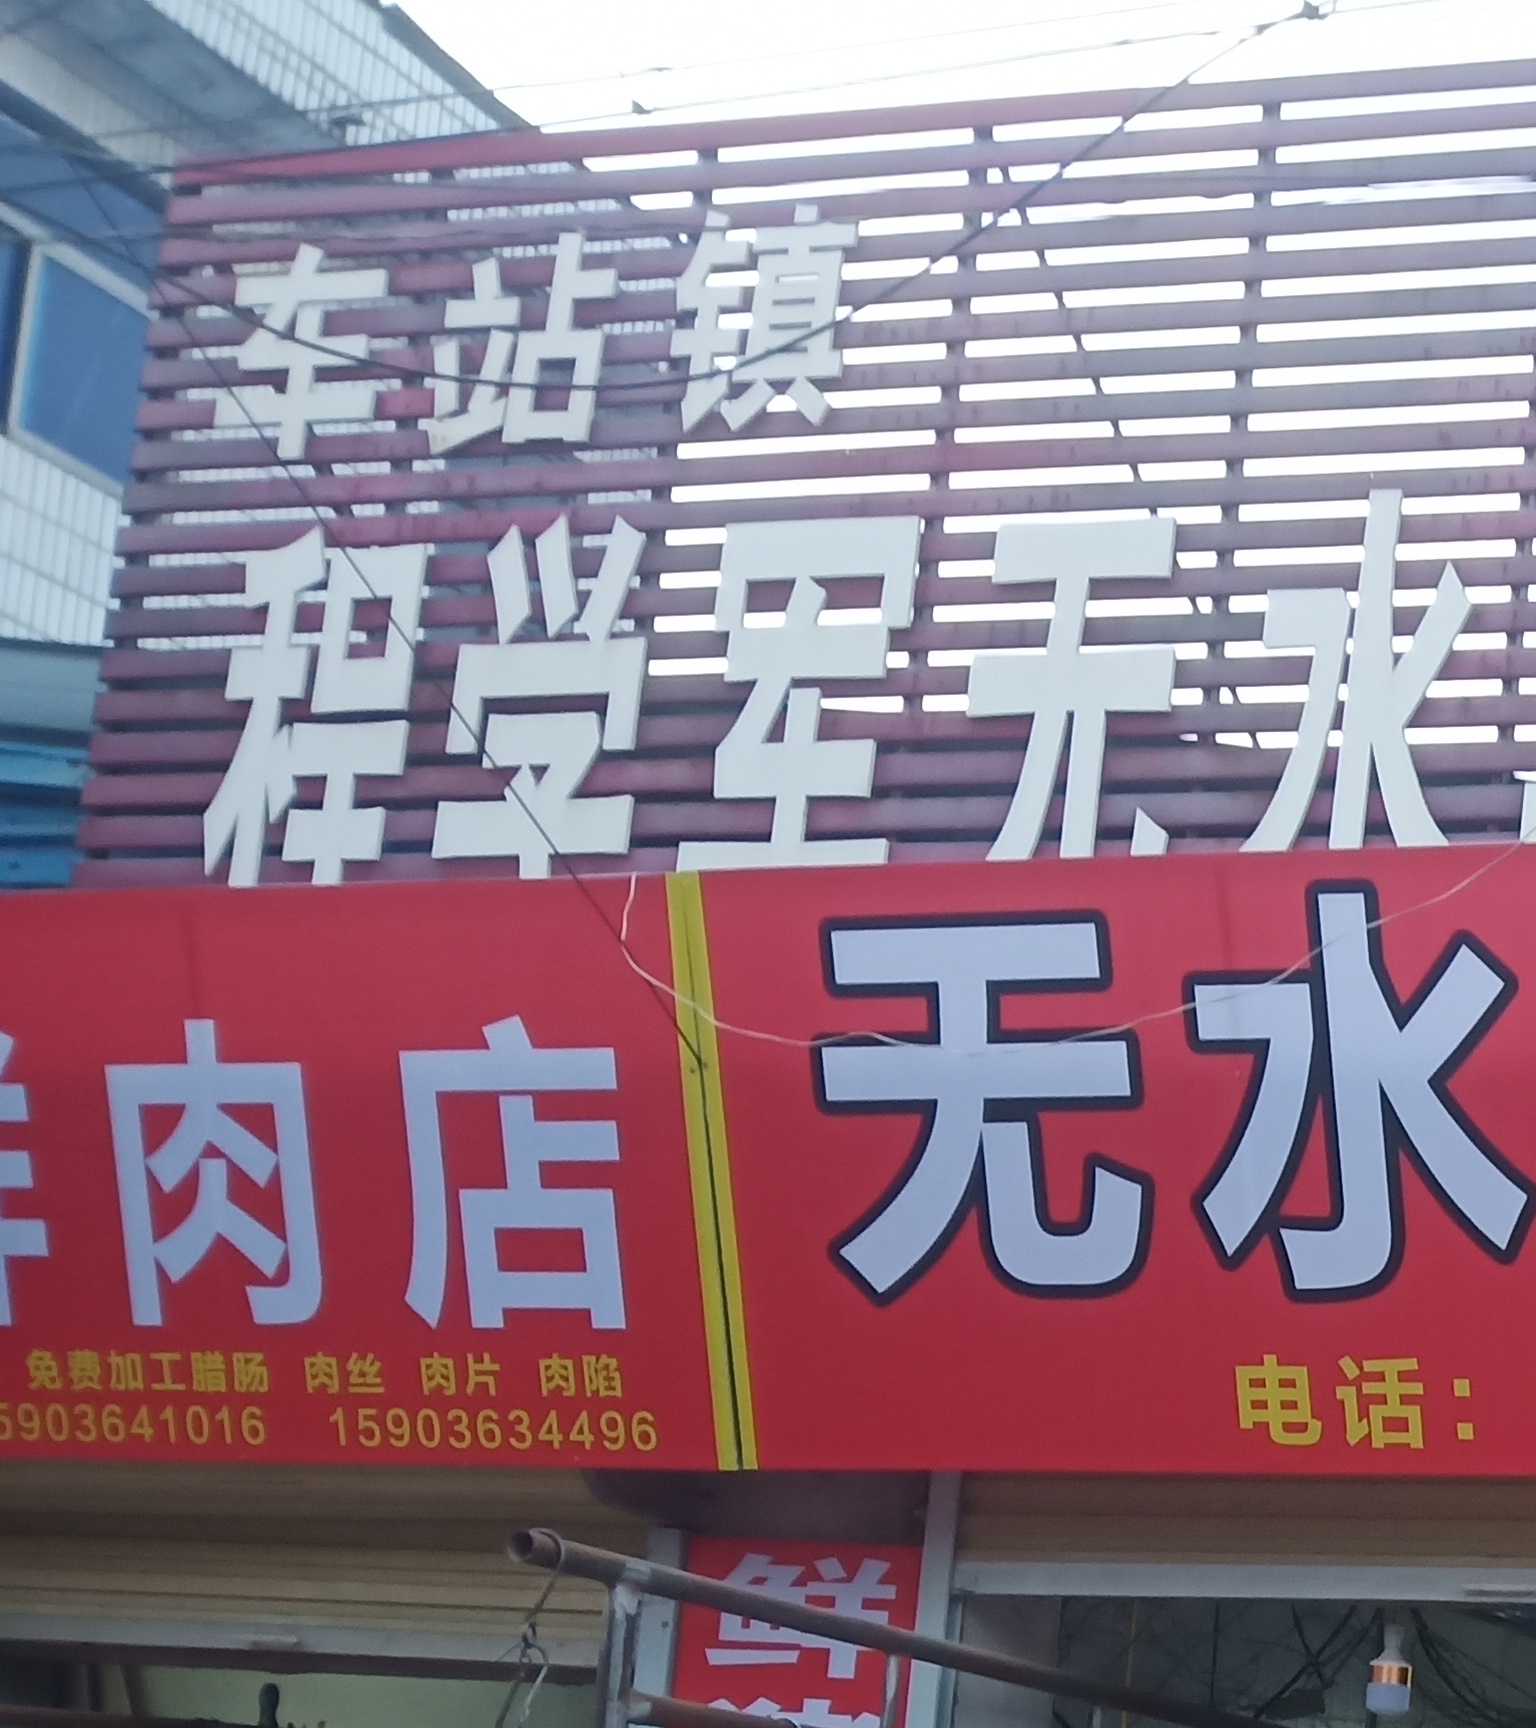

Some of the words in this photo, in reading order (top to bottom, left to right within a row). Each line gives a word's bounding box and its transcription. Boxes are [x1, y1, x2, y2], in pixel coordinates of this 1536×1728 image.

[214, 204, 859, 460] 车站镇
[303, 1352, 385, 1395] 肉丝
[420, 1352, 500, 1396] 肉片
[328, 1407, 657, 1451] 15903634496
